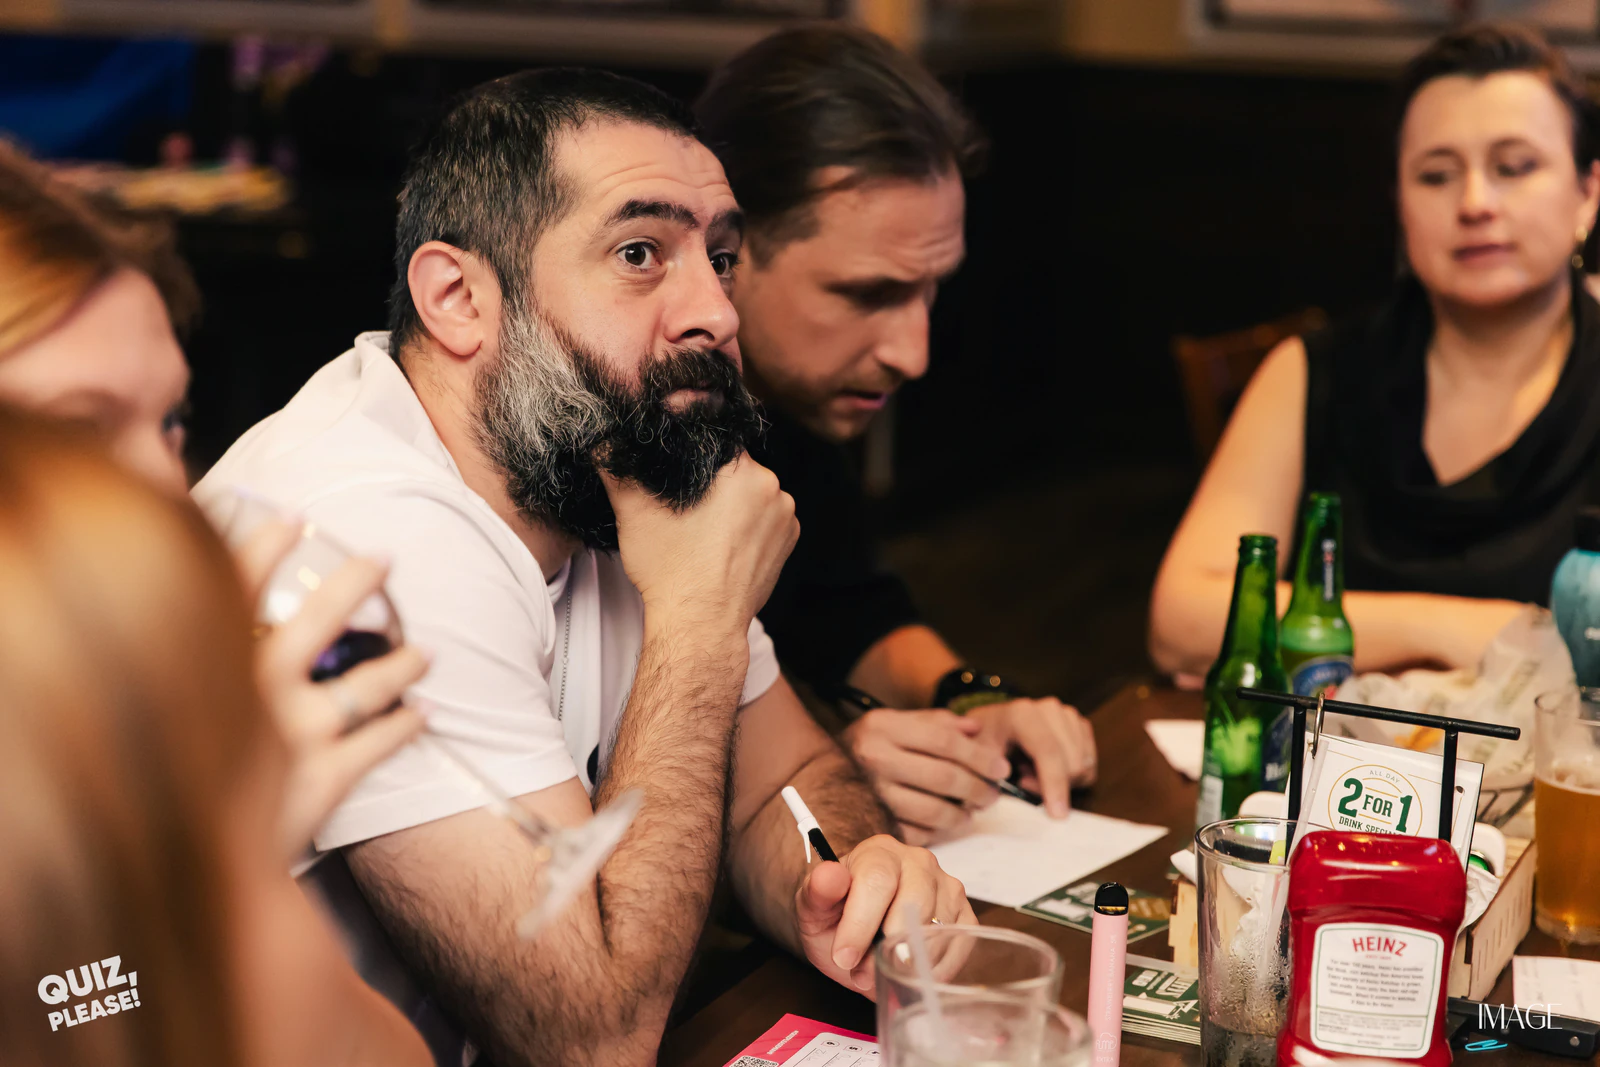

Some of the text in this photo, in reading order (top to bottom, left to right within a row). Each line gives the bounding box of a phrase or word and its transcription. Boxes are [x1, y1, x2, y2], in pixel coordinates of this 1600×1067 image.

[1385, 772, 1400, 784] DAY
[1337, 777, 1413, 833] 2 FOR 1
[1338, 815, 1364, 831] DRINK
[1352, 936, 1408, 957] HEINZ
